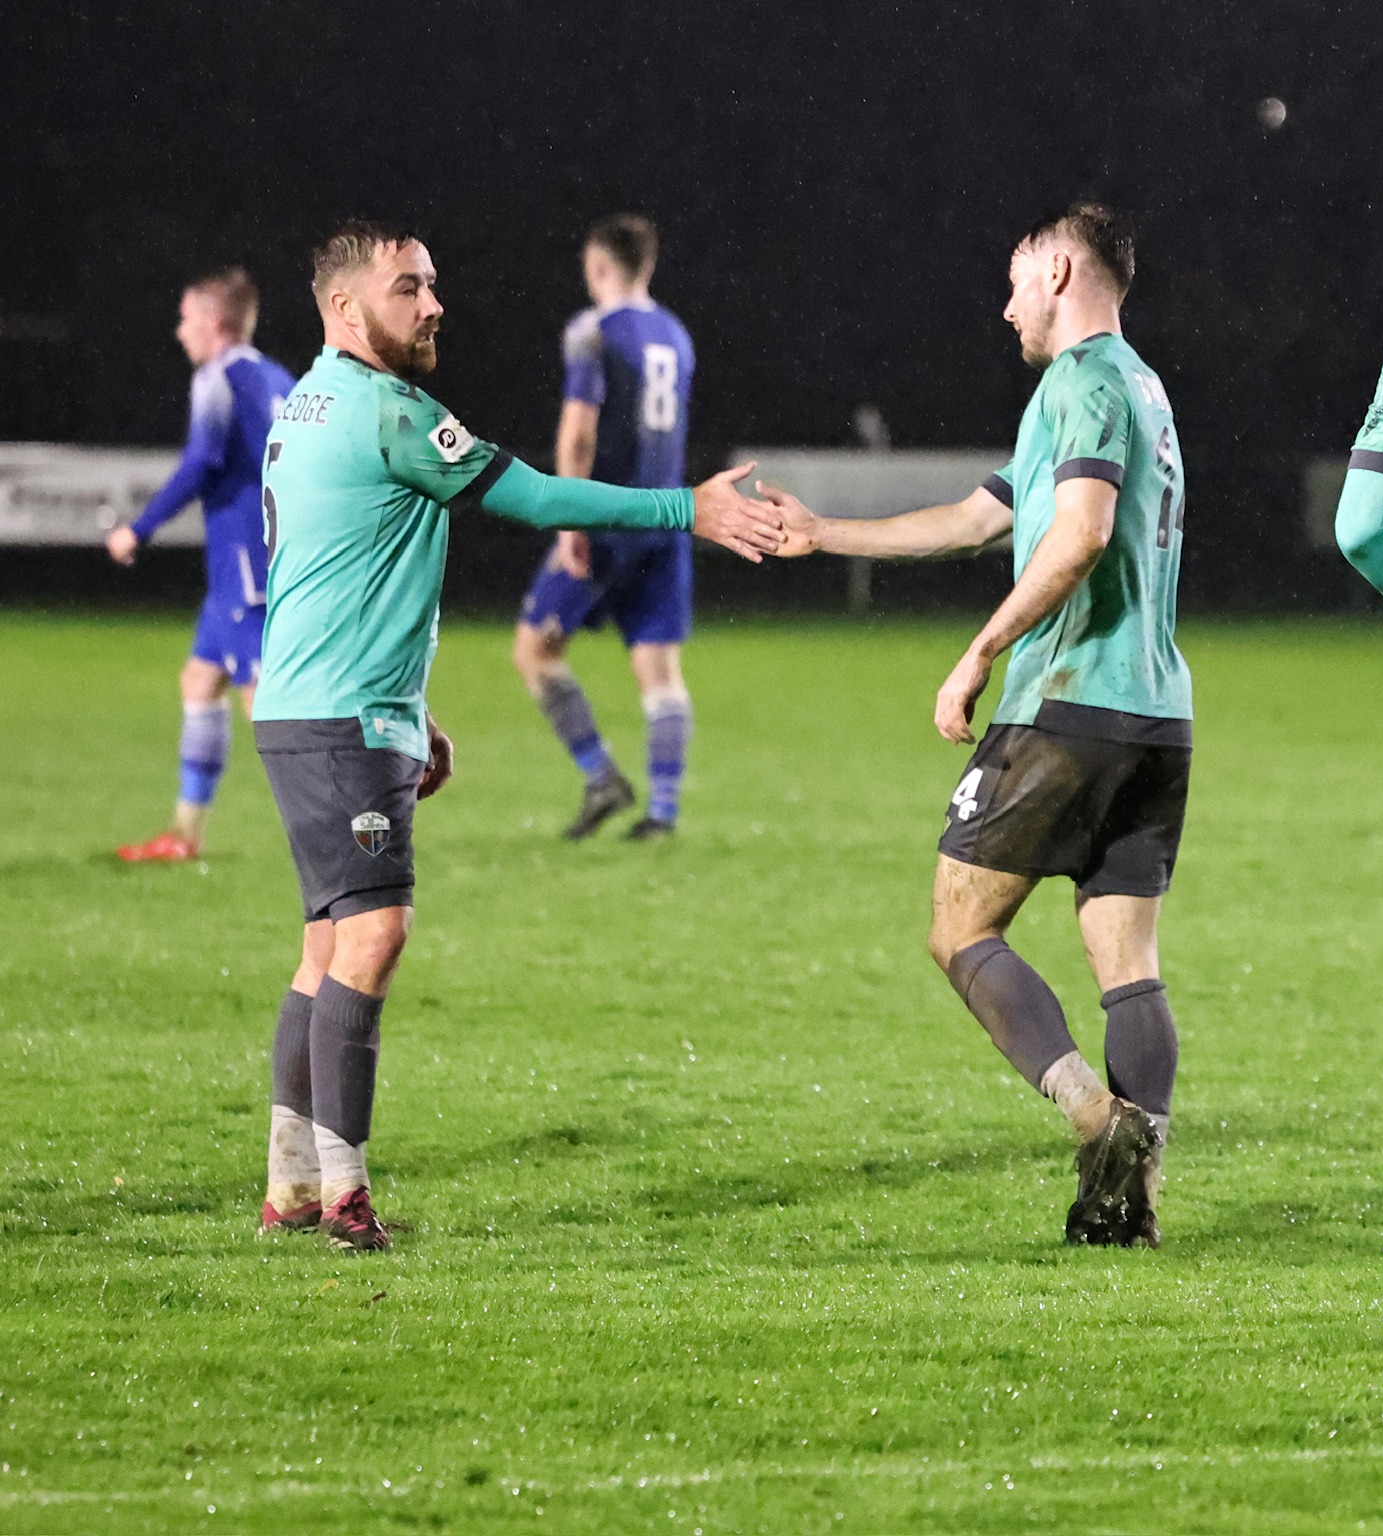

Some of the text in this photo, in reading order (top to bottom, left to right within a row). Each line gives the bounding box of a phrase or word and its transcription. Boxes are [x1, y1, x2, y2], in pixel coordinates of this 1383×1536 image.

[277, 393, 336, 424] EDGE
[643, 342, 679, 432] 8
[951, 767, 983, 821] 4
